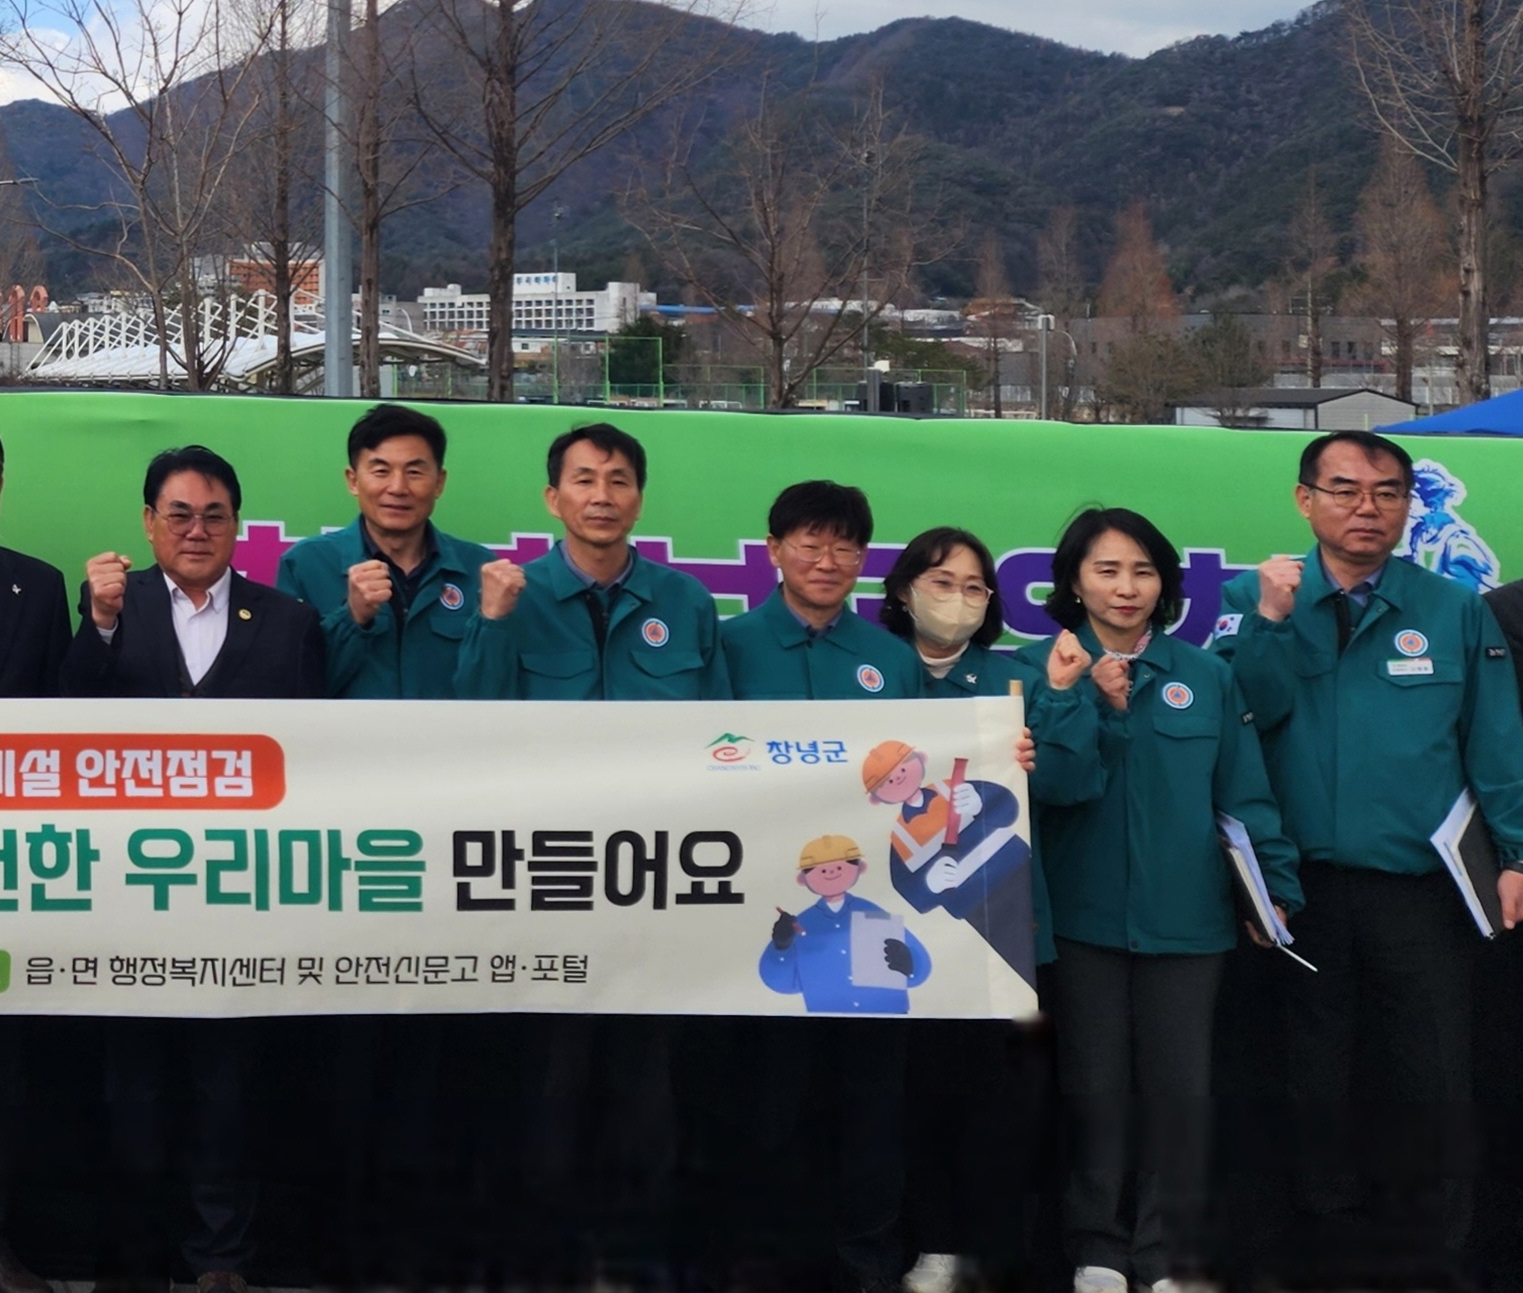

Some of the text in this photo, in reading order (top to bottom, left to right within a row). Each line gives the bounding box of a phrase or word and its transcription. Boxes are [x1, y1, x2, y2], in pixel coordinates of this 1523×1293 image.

[76, 747, 254, 797] 안전점검
[765, 740, 849, 765] 창녕군
[125, 828, 426, 911] 우리마을
[452, 829, 745, 911] 만들어요
[25, 956, 99, 986] 읍·면
[109, 956, 286, 988] 행정복지센터
[297, 956, 324, 986] 및
[334, 955, 479, 985] 안전신문고
[490, 953, 589, 984] 앱·포털
